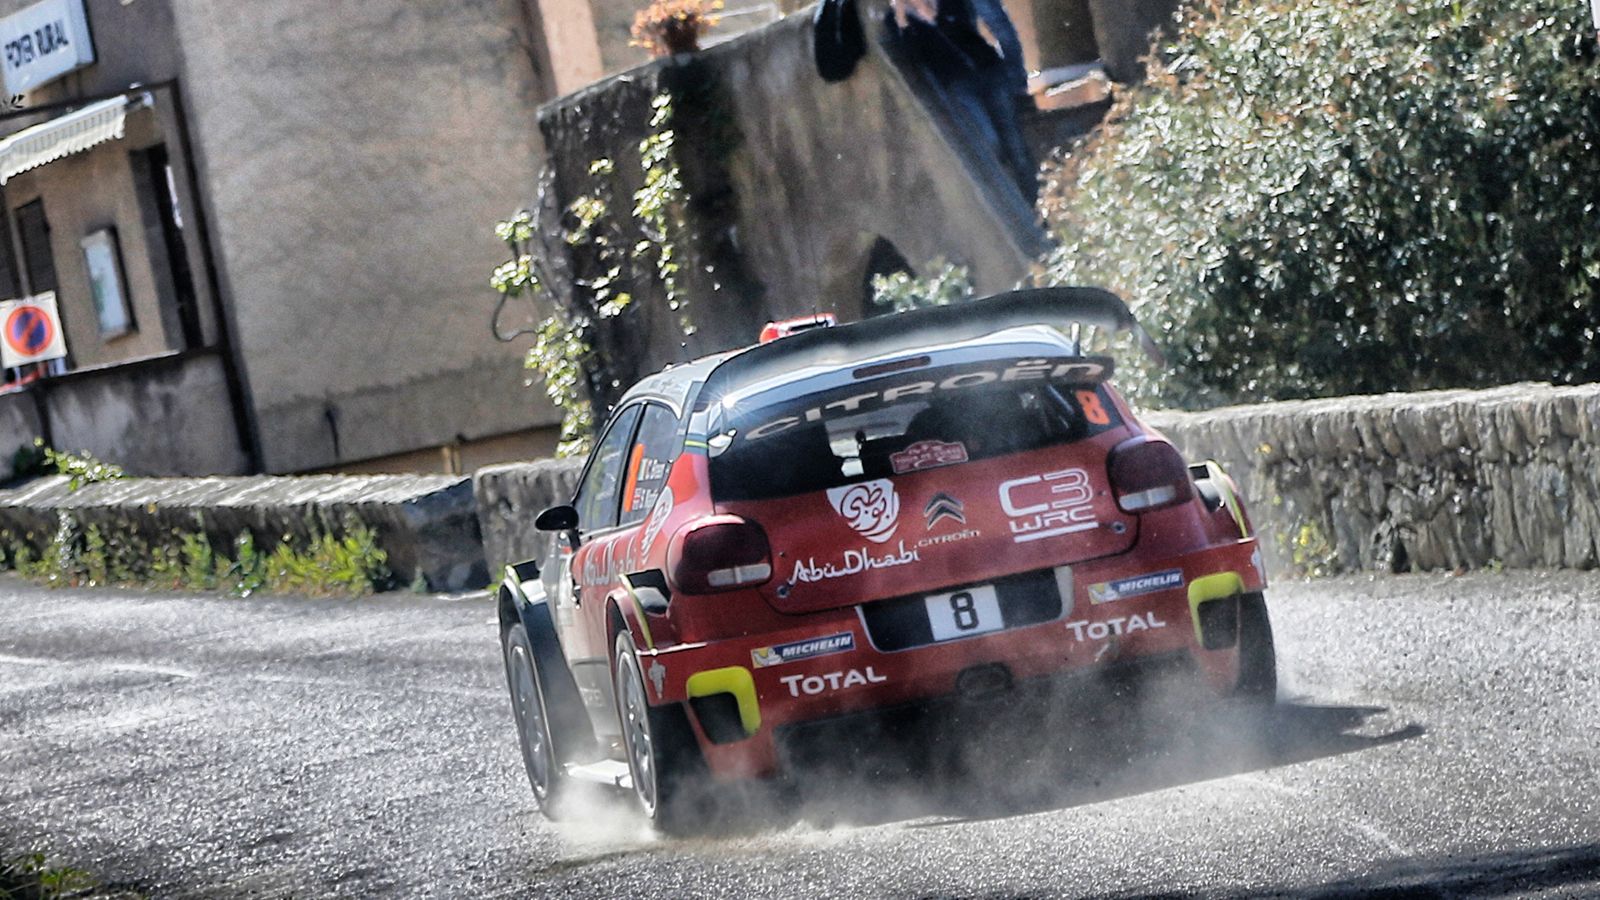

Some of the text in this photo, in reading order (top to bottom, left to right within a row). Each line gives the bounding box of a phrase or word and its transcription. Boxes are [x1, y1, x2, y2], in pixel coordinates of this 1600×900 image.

[1077, 390, 1110, 426] 8
[999, 468, 1093, 517] C3
[1009, 505, 1096, 533] WRC
[1118, 573, 1181, 593] MICHELIN
[949, 592, 979, 631] 8
[1065, 611, 1166, 642] TOTAL
[782, 635, 852, 658] MICHELIN
[780, 666, 887, 697] TOTAL
